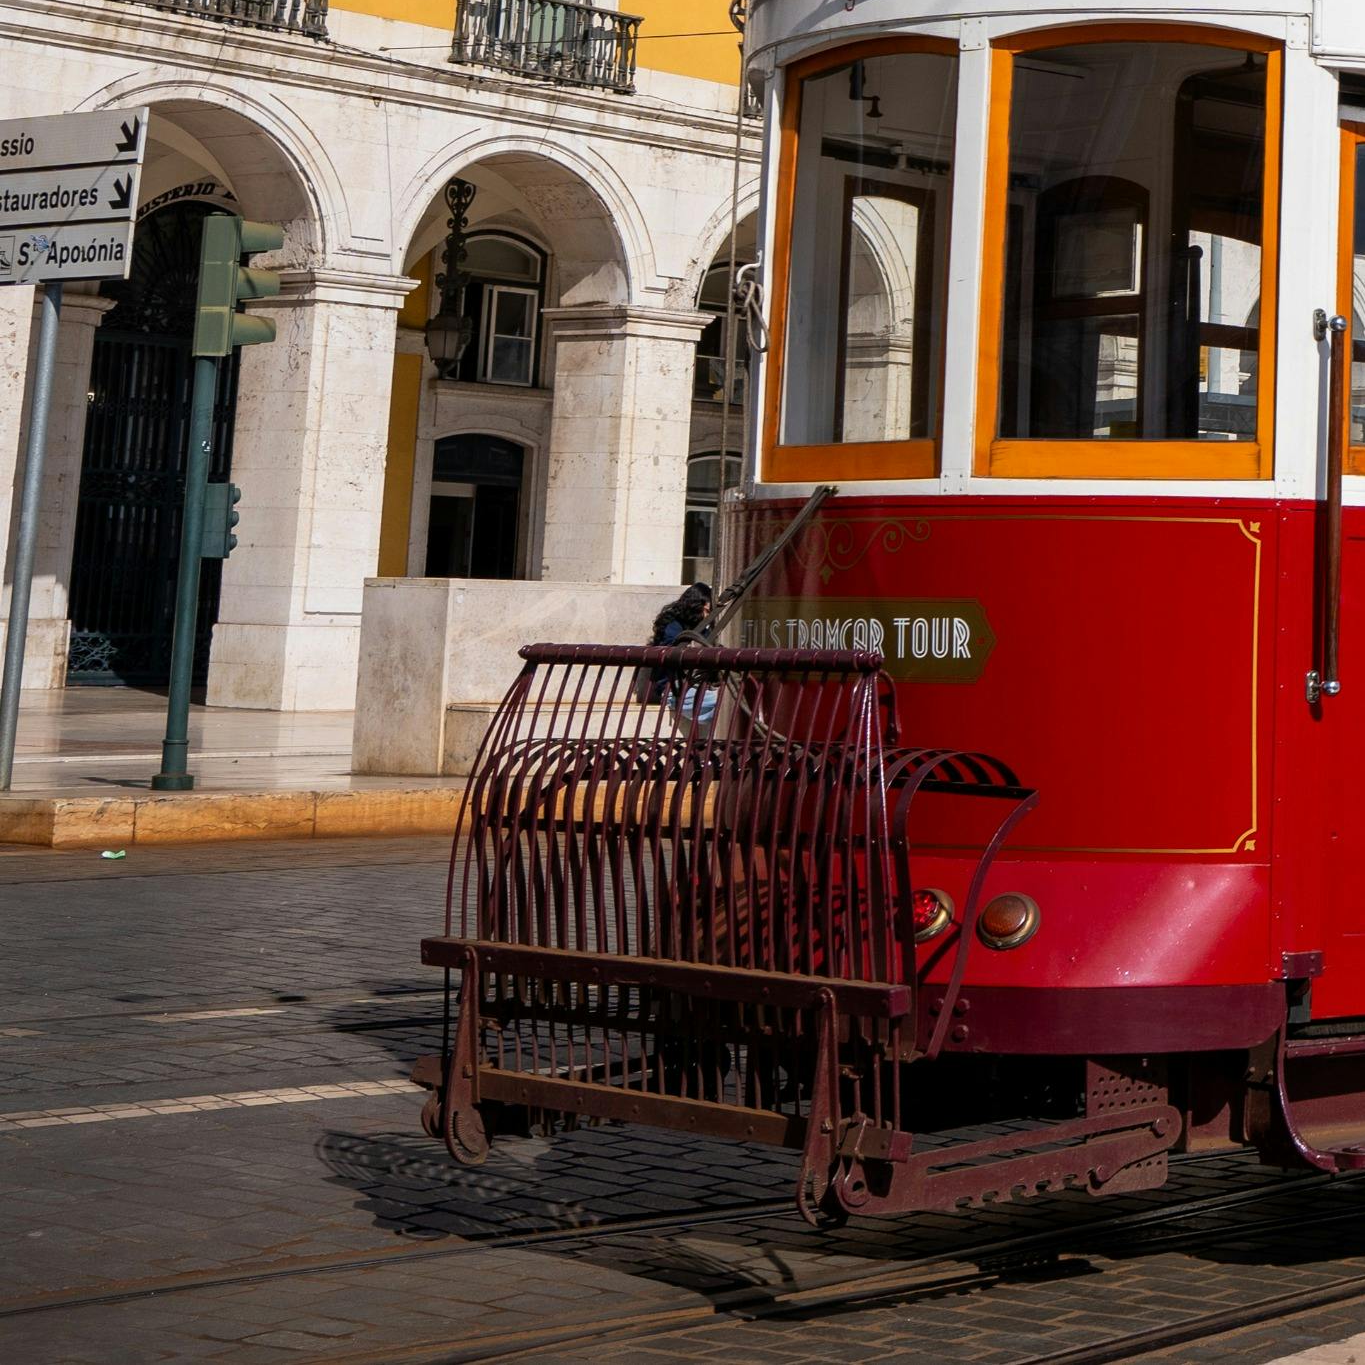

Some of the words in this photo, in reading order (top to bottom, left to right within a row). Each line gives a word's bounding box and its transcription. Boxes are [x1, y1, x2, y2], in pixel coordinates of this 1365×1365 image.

[0, 185, 98, 212] tauradores
[786, 618, 885, 658] TRAMCAR
[893, 617, 971, 659] TOUR
